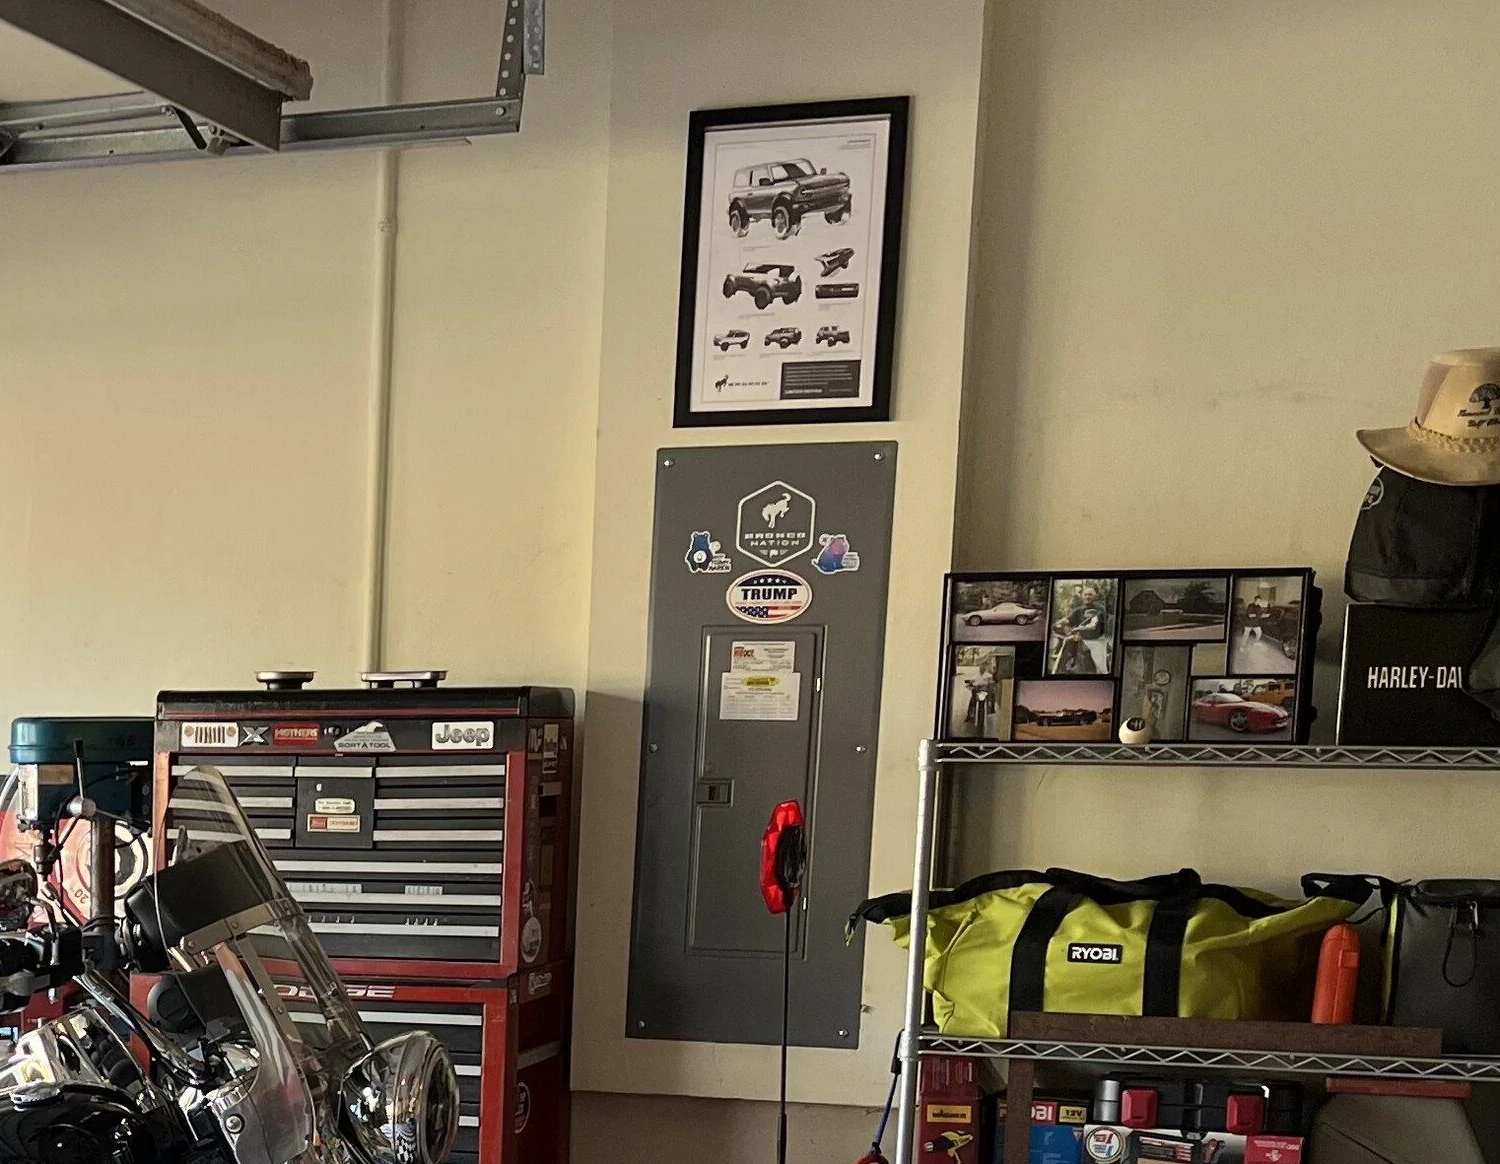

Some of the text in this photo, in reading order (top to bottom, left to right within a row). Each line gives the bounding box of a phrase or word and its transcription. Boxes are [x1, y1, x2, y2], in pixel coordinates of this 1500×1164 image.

[744, 532, 806, 540] BRONCO
[741, 588, 798, 601] TRUMP
[275, 728, 319, 738] MOTHERS
[435, 724, 491, 746] Jeep
[1071, 946, 1119, 961] RYOBI
[1066, 1109, 1082, 1117] 12V
